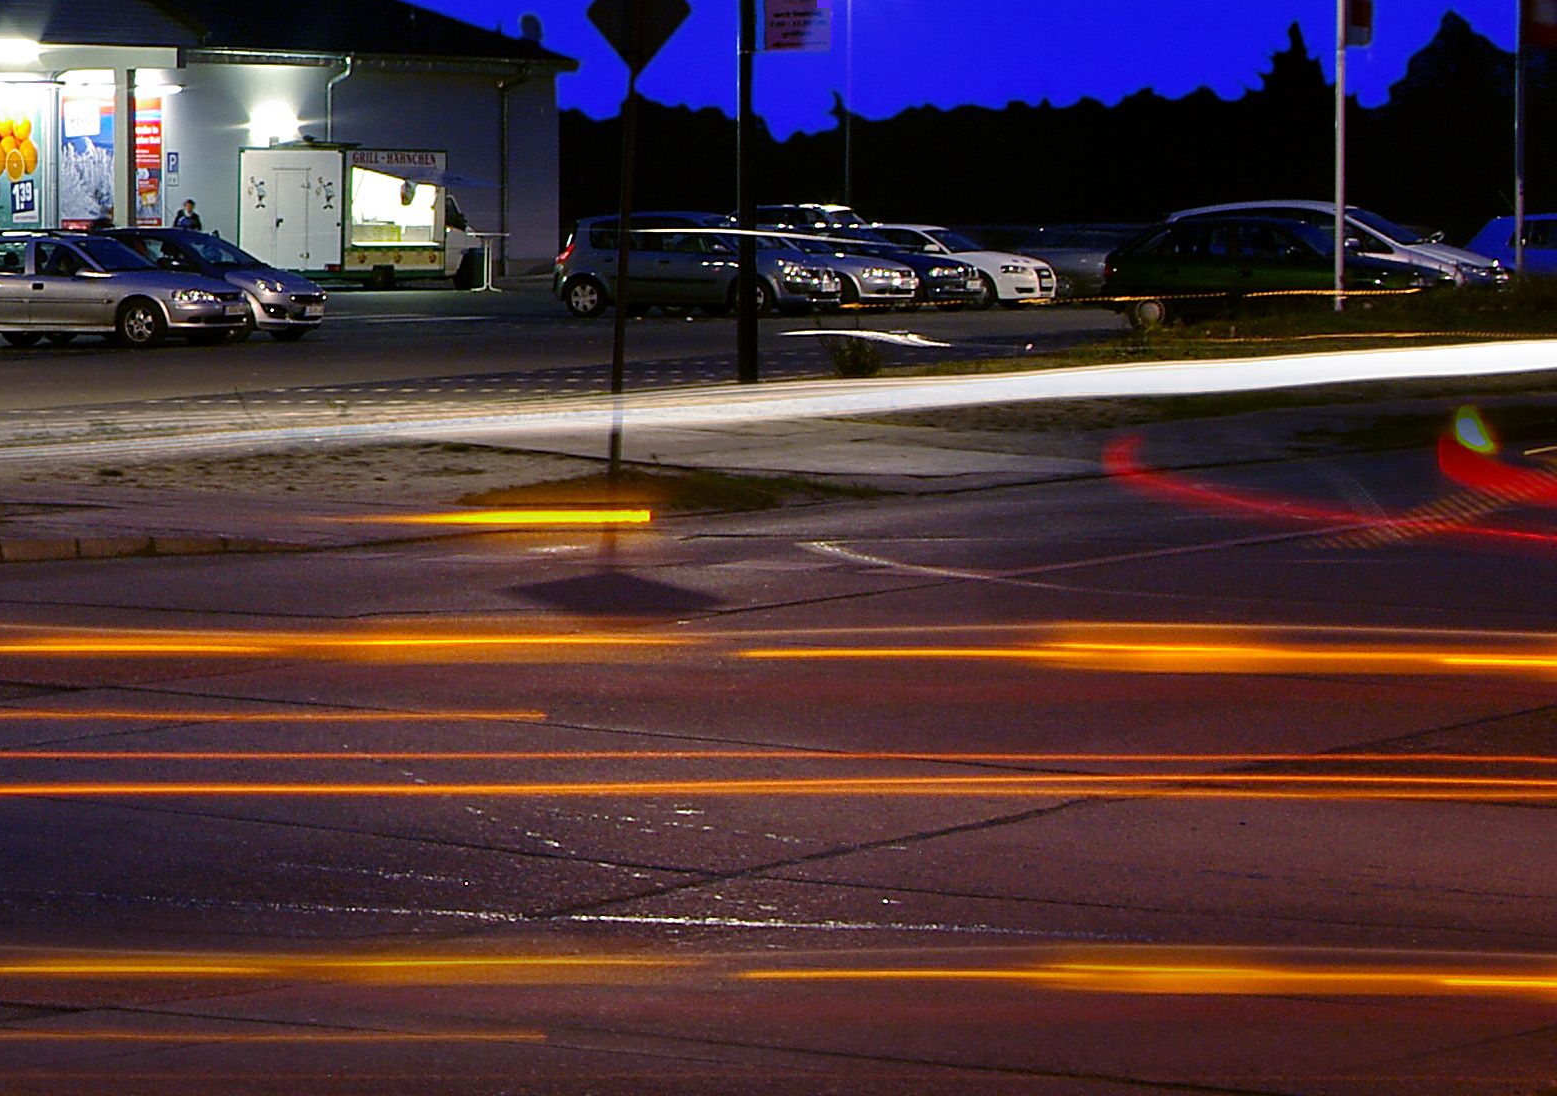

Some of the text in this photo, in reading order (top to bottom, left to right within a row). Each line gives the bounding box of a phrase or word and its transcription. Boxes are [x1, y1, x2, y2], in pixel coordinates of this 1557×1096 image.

[168, 154, 177, 171] P
[352, 151, 380, 164] GRILL
[12, 181, 33, 211] 1.39
